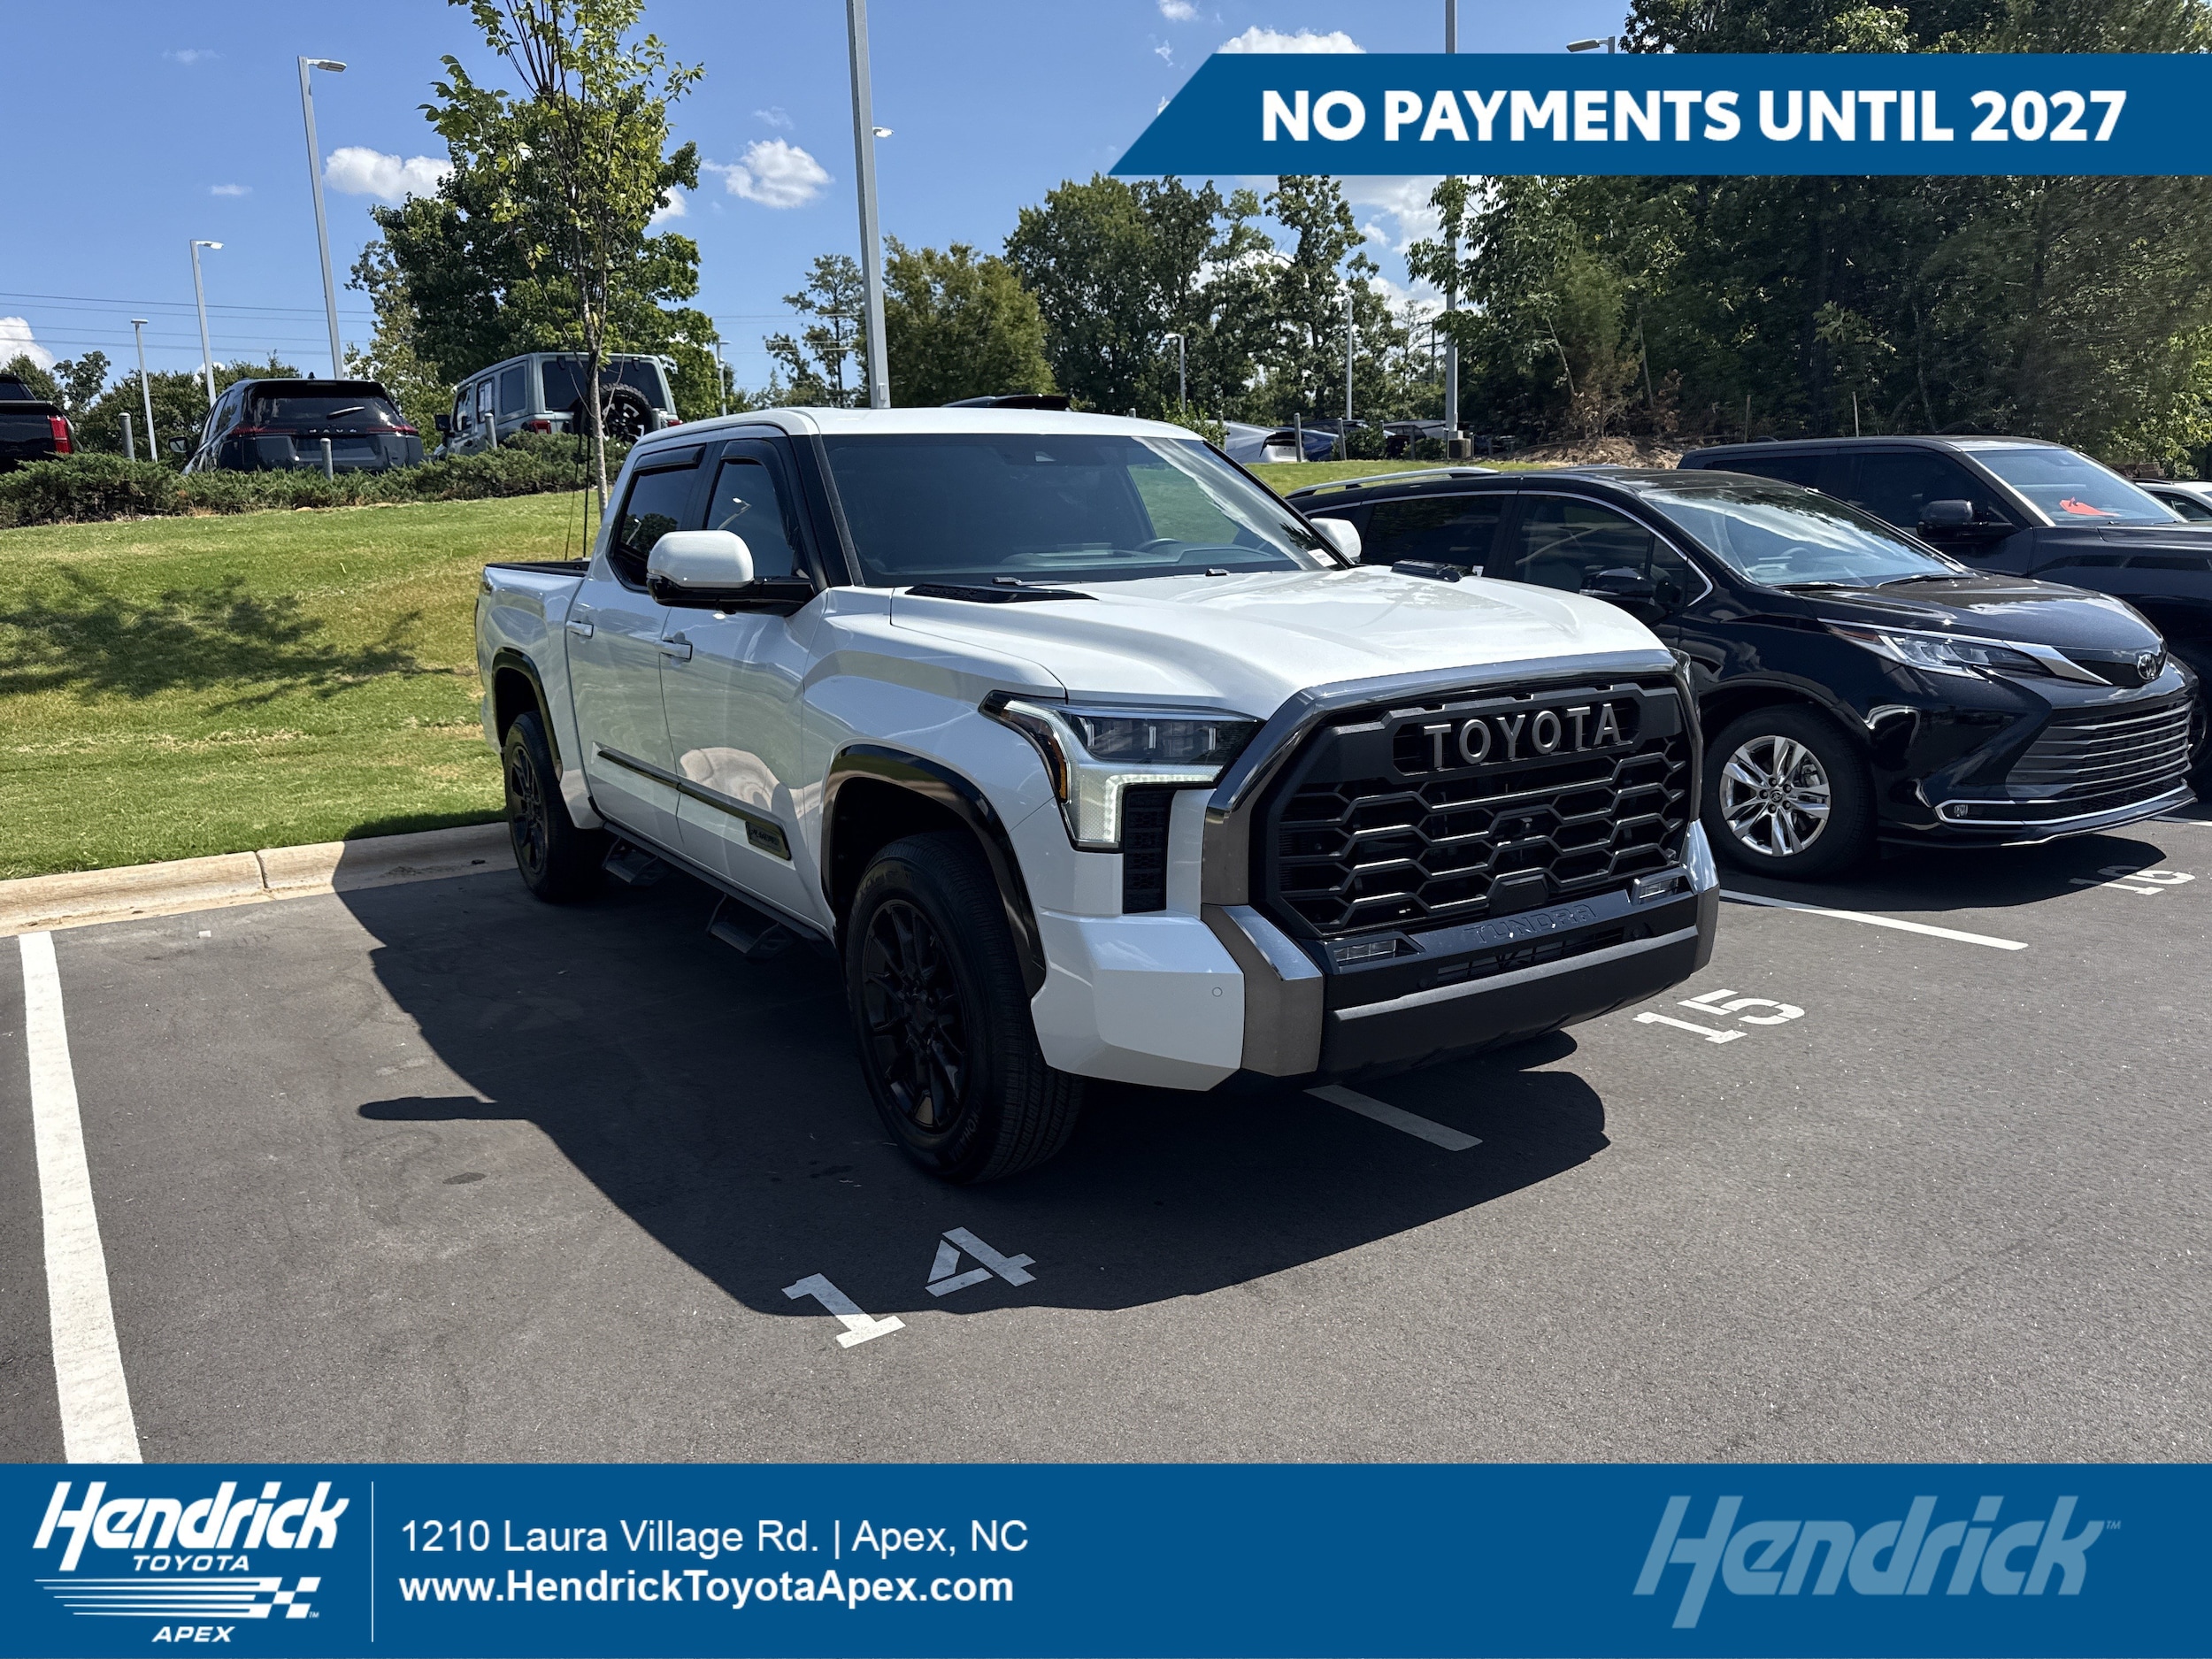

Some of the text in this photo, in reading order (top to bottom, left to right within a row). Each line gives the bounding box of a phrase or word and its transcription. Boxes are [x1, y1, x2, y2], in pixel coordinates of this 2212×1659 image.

[1424, 703, 1622, 770] TOYOTA
[2067, 864, 2196, 895] 16
[1463, 903, 1598, 944] TUNDRA
[1632, 988, 1805, 1044] 15
[781, 1226, 1037, 1348] 14
